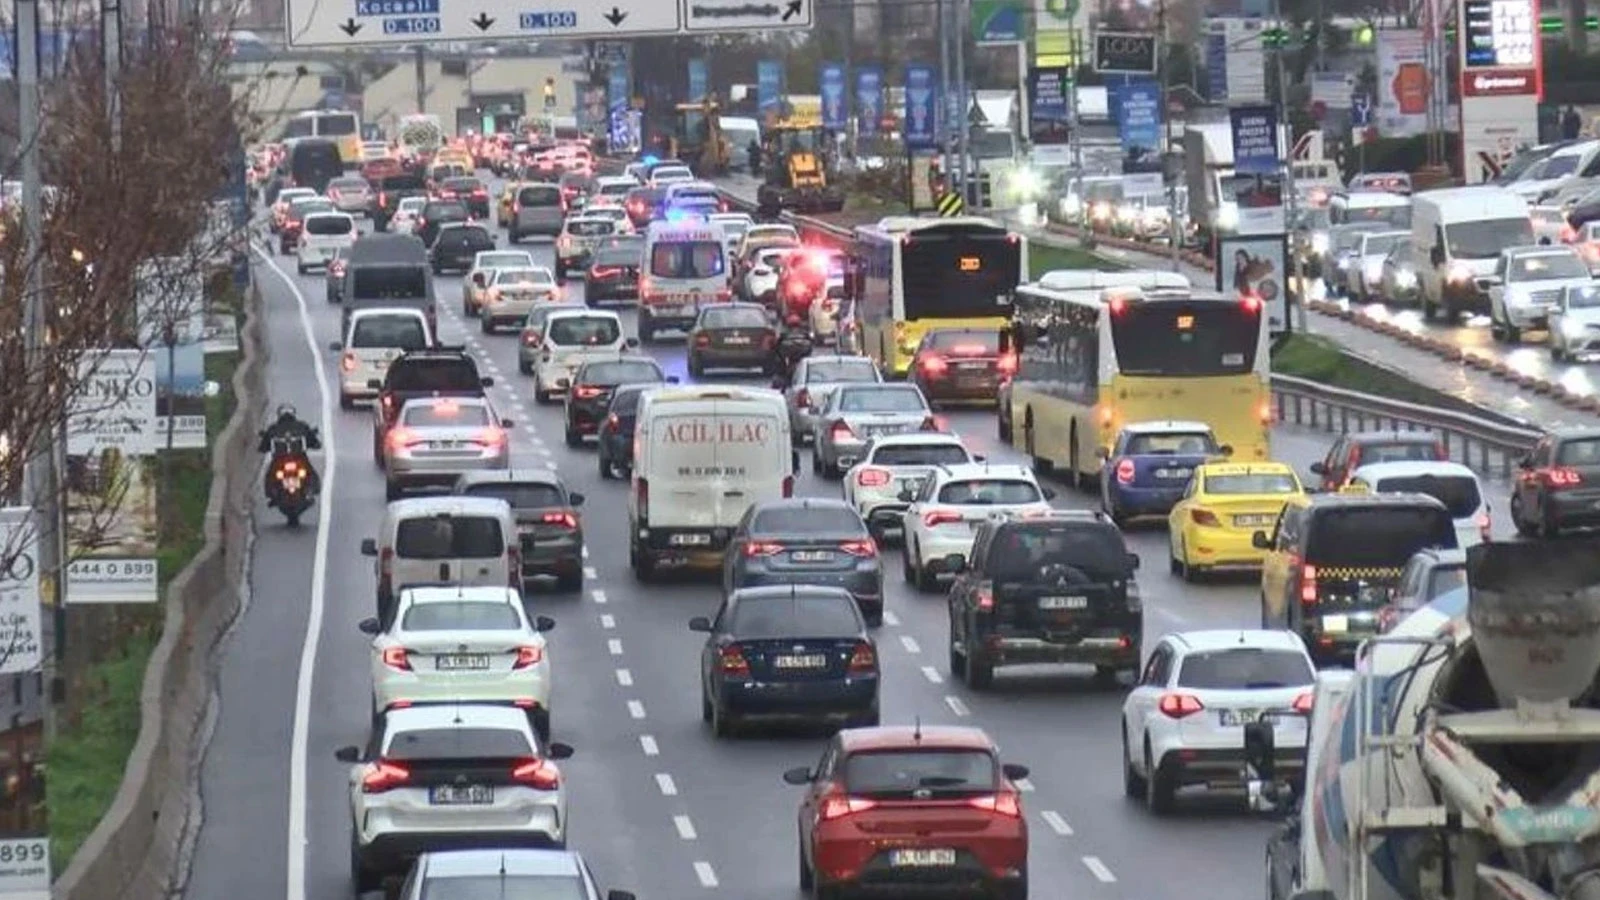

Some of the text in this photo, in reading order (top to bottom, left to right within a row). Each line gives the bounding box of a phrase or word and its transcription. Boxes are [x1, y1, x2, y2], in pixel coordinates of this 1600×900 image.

[357, 0, 428, 14] Kocaeli
[663, 419, 714, 443] ACİL
[70, 563, 100, 574] 444
[124, 563, 154, 575] 899
[0, 843, 45, 862] 899
